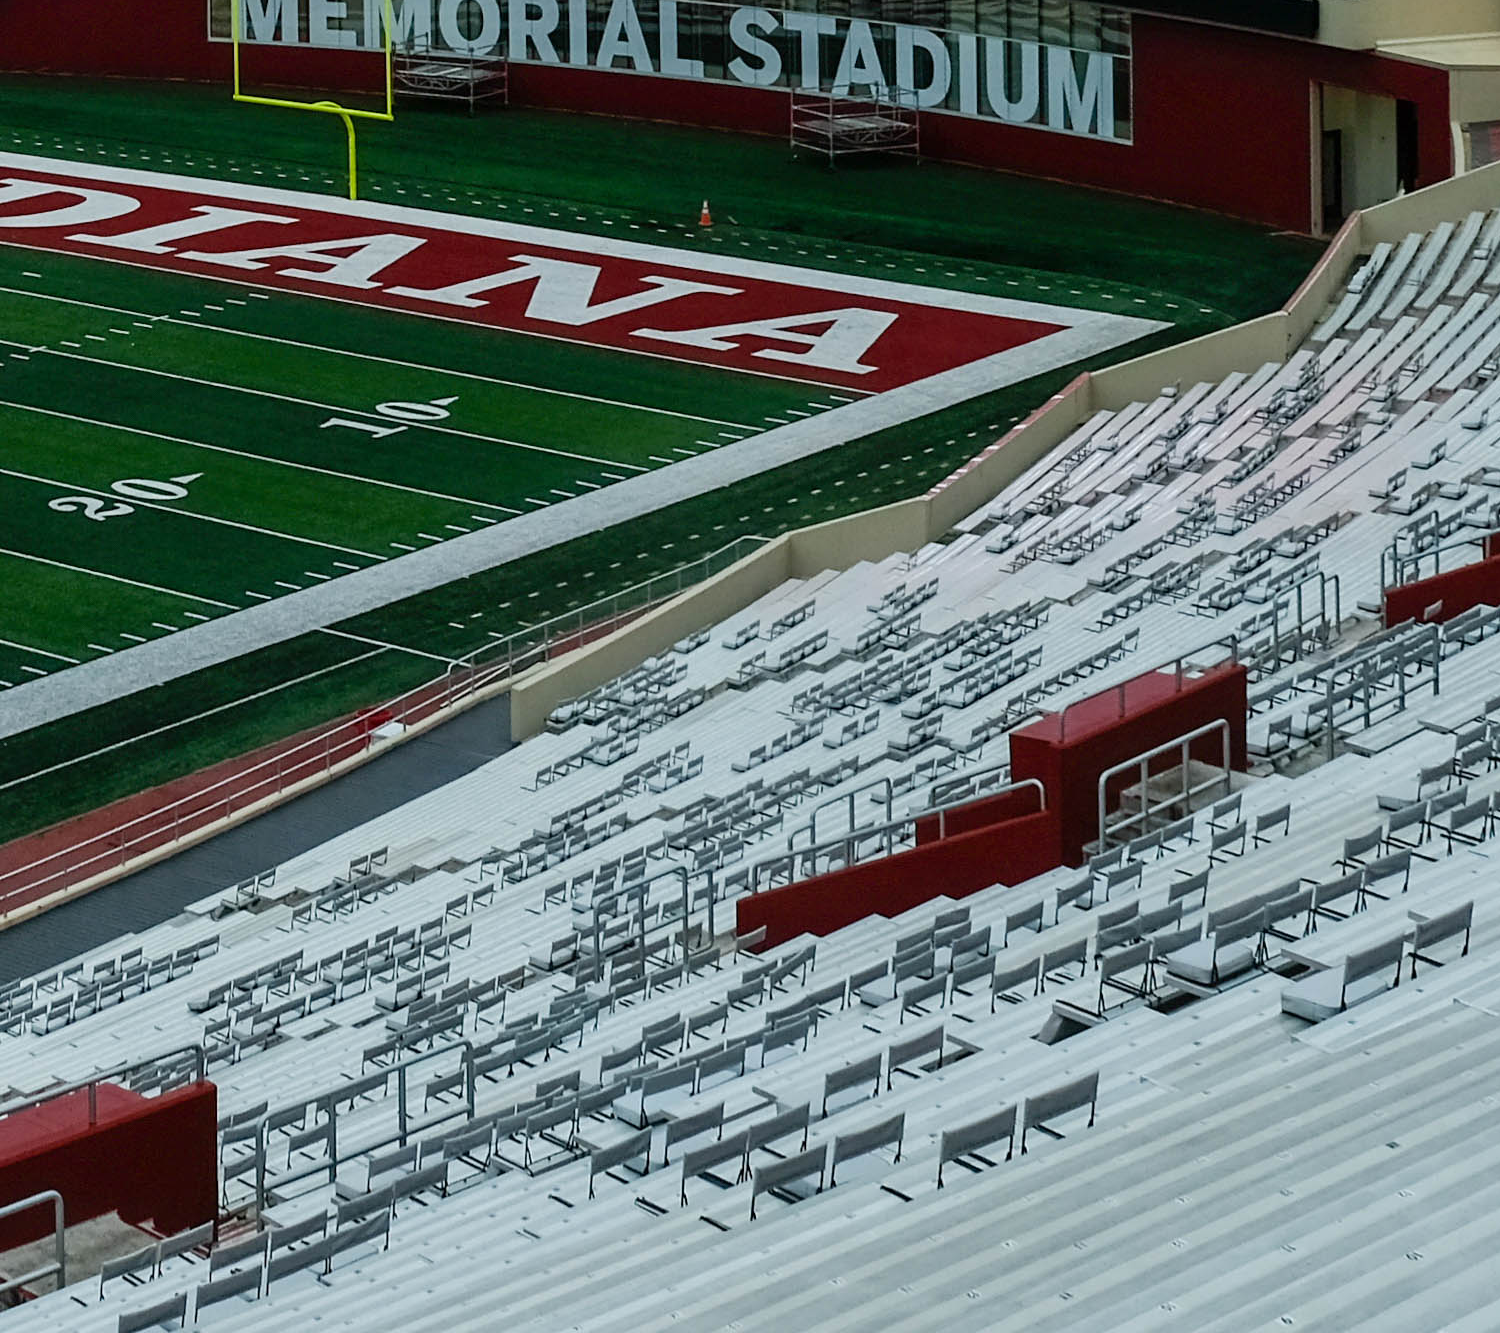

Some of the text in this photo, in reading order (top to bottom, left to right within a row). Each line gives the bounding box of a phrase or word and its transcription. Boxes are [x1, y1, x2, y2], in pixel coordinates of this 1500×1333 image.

[728, 5, 1115, 138] STADIUM
[320, 400, 450, 439] 10
[48, 478, 188, 522] 20
